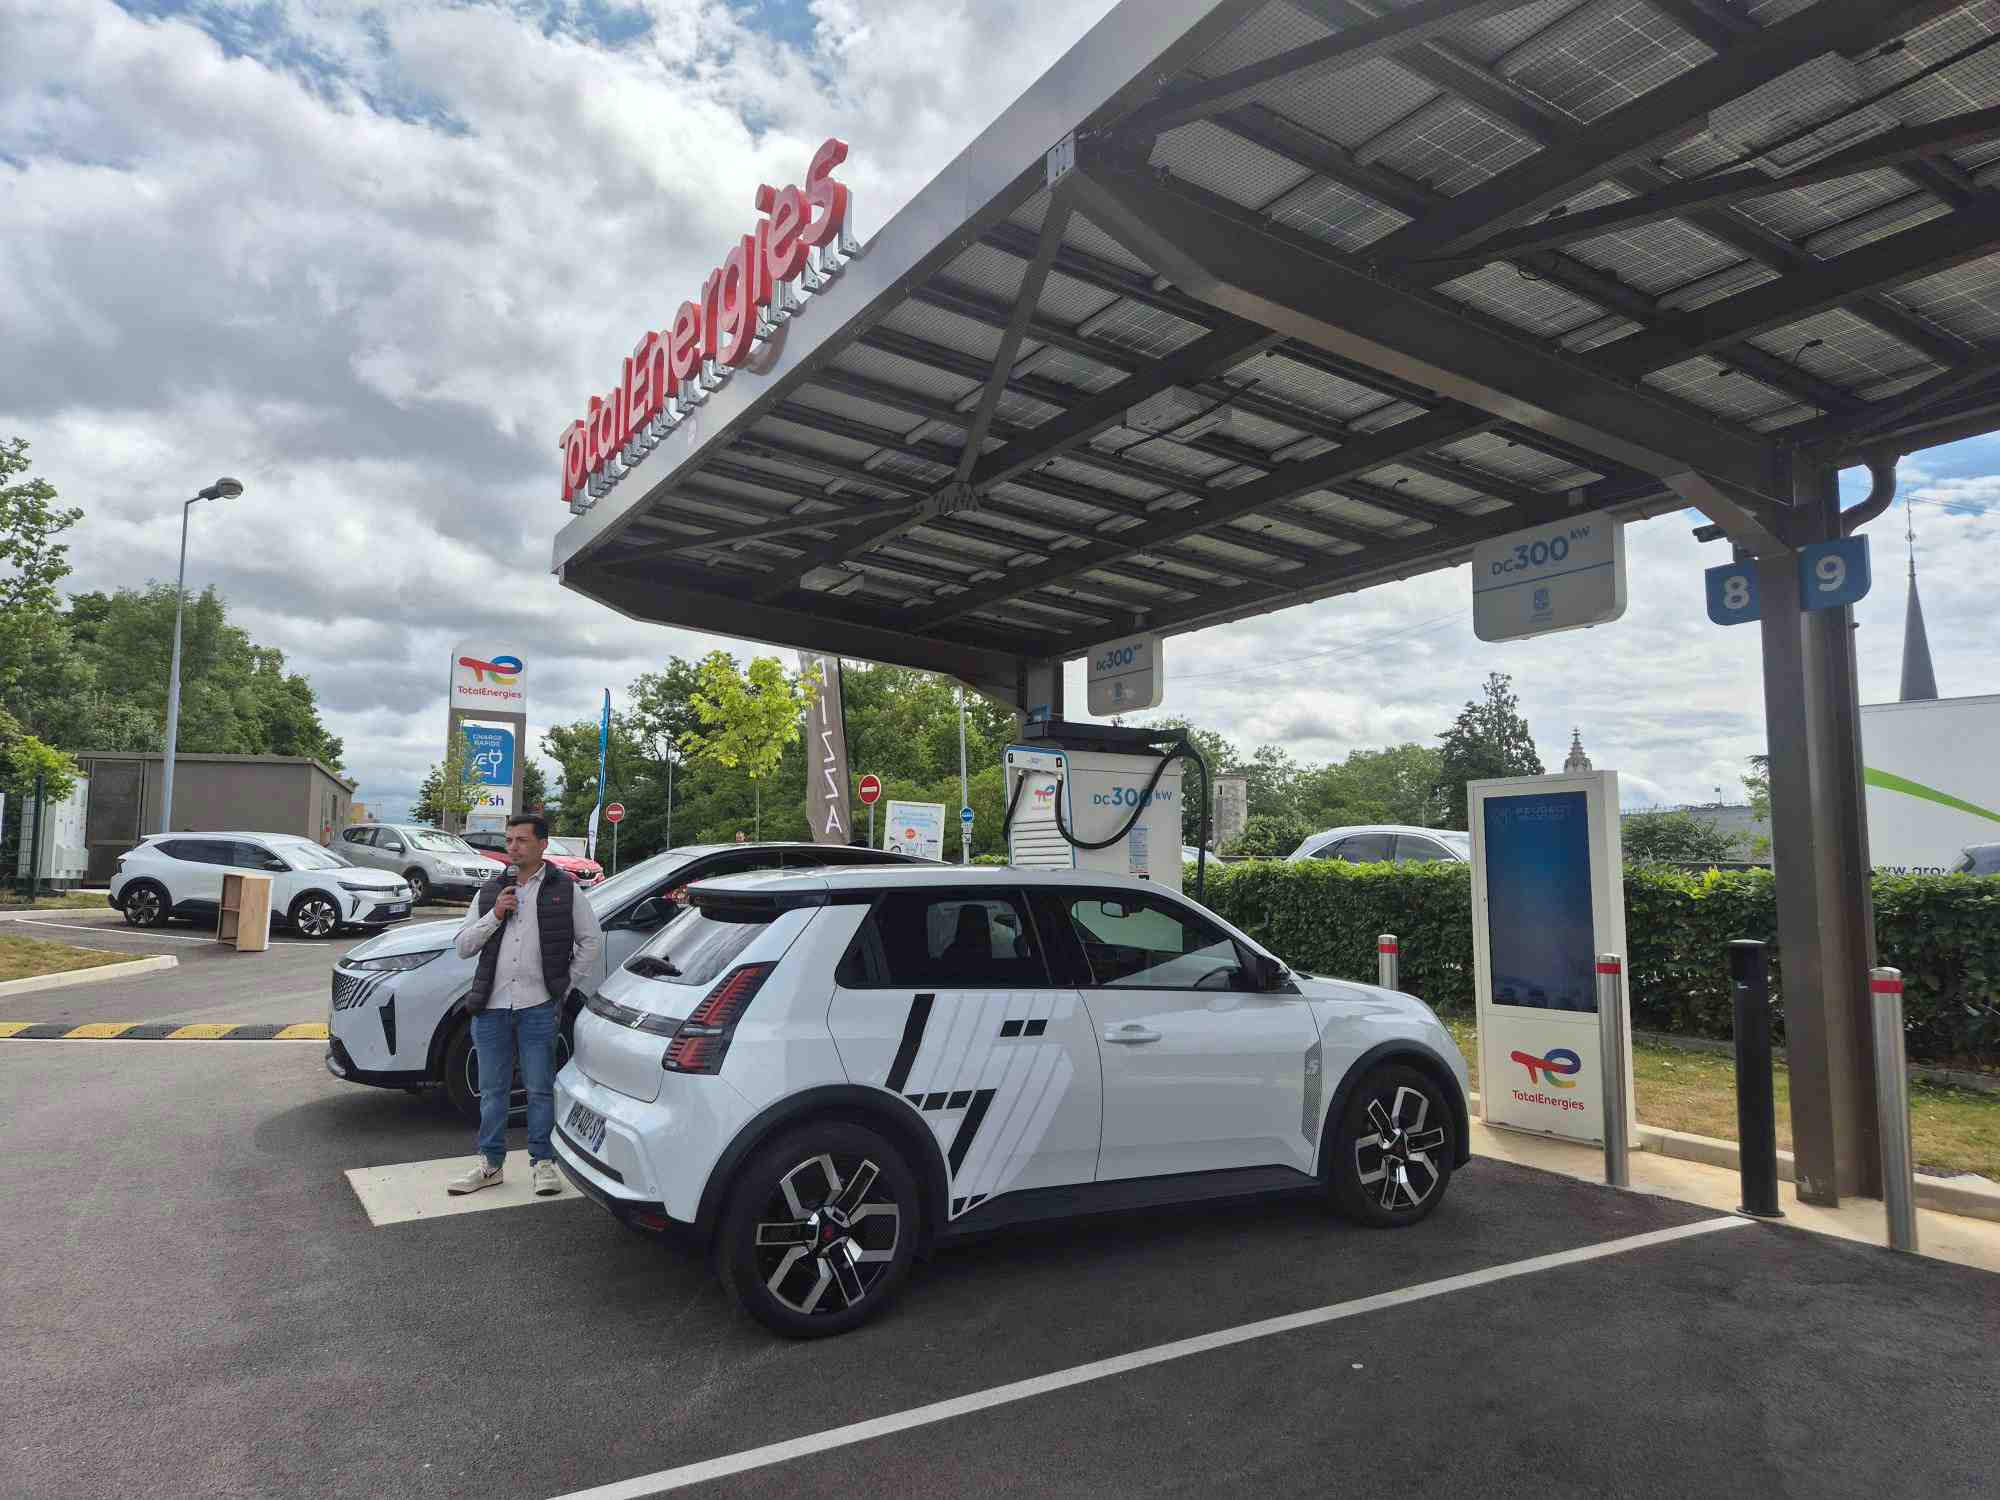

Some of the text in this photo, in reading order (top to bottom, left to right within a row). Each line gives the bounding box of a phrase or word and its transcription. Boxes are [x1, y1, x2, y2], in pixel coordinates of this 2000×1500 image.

[1816, 555, 1846, 592] 9
[1723, 575, 1750, 610] 8
[457, 685, 522, 700] TotalEnergies
[1512, 1089, 1585, 1111] TotalEnergies
